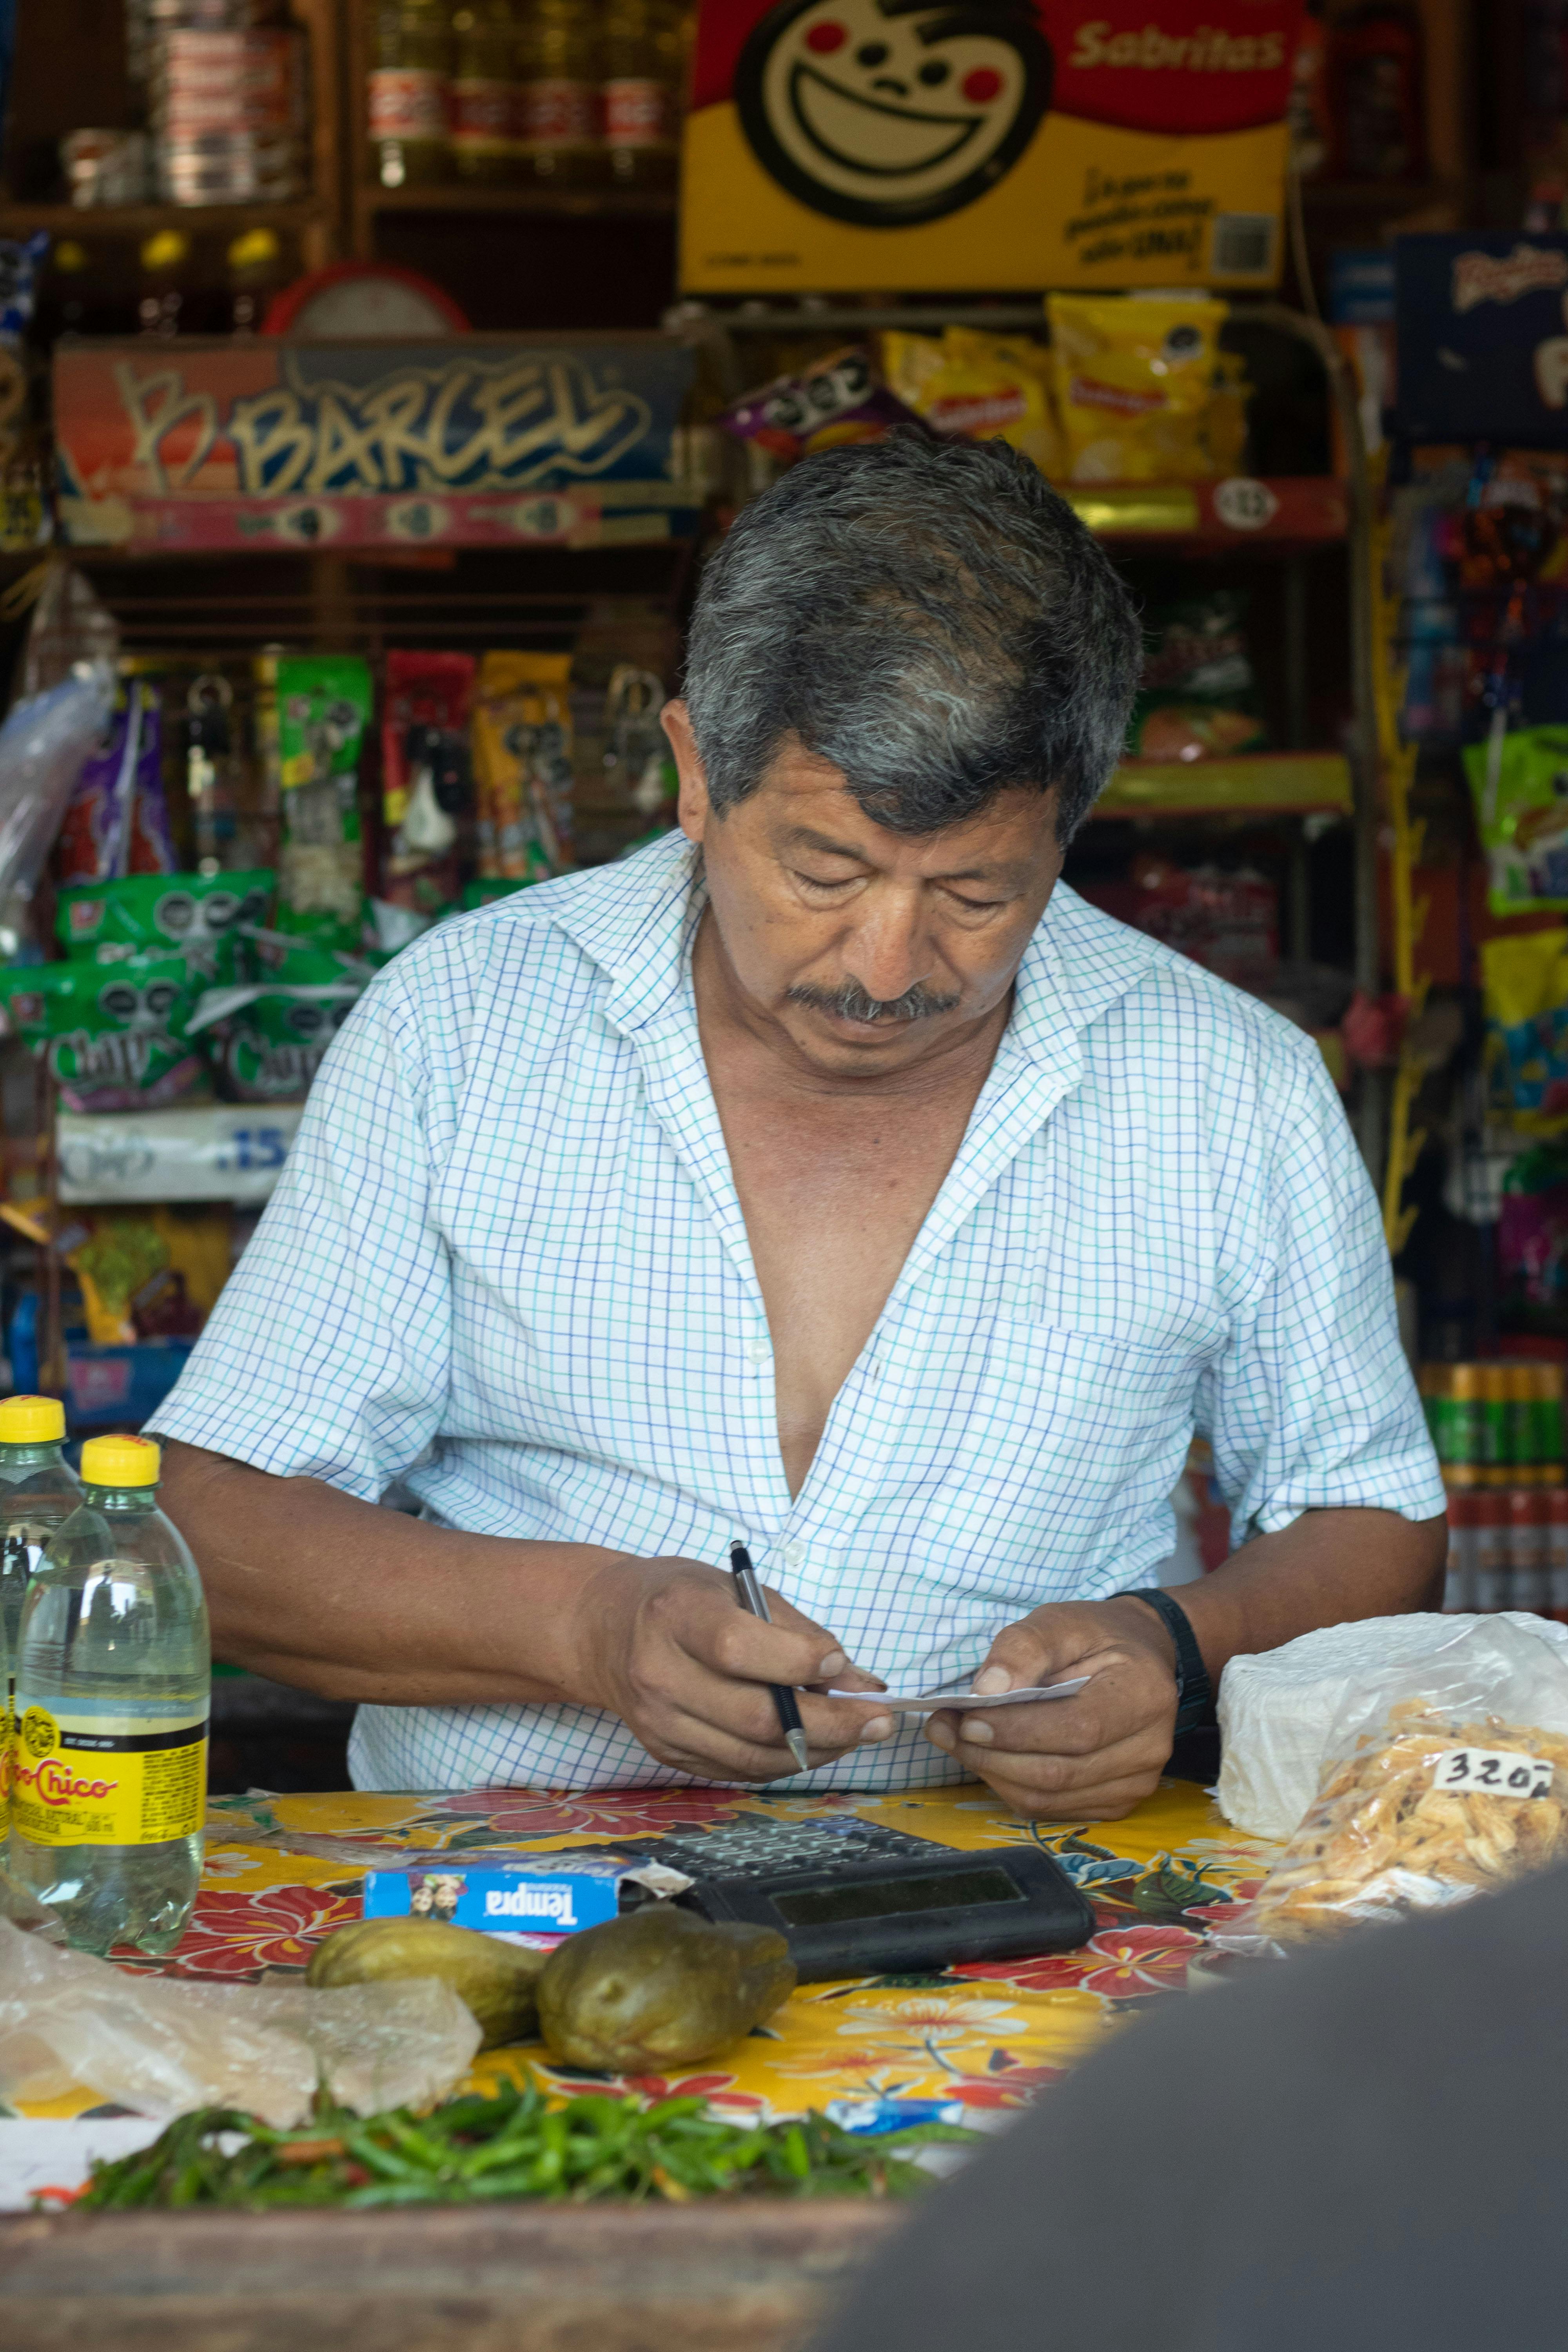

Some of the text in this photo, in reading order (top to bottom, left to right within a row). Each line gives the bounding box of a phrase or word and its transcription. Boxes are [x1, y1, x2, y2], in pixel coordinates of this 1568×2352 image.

[1071, 22, 1285, 71] Sabritas
[230, 362, 629, 495] BARCEL
[36, 1759, 118, 1806] Chico
[486, 1882, 578, 1926] Tempra
